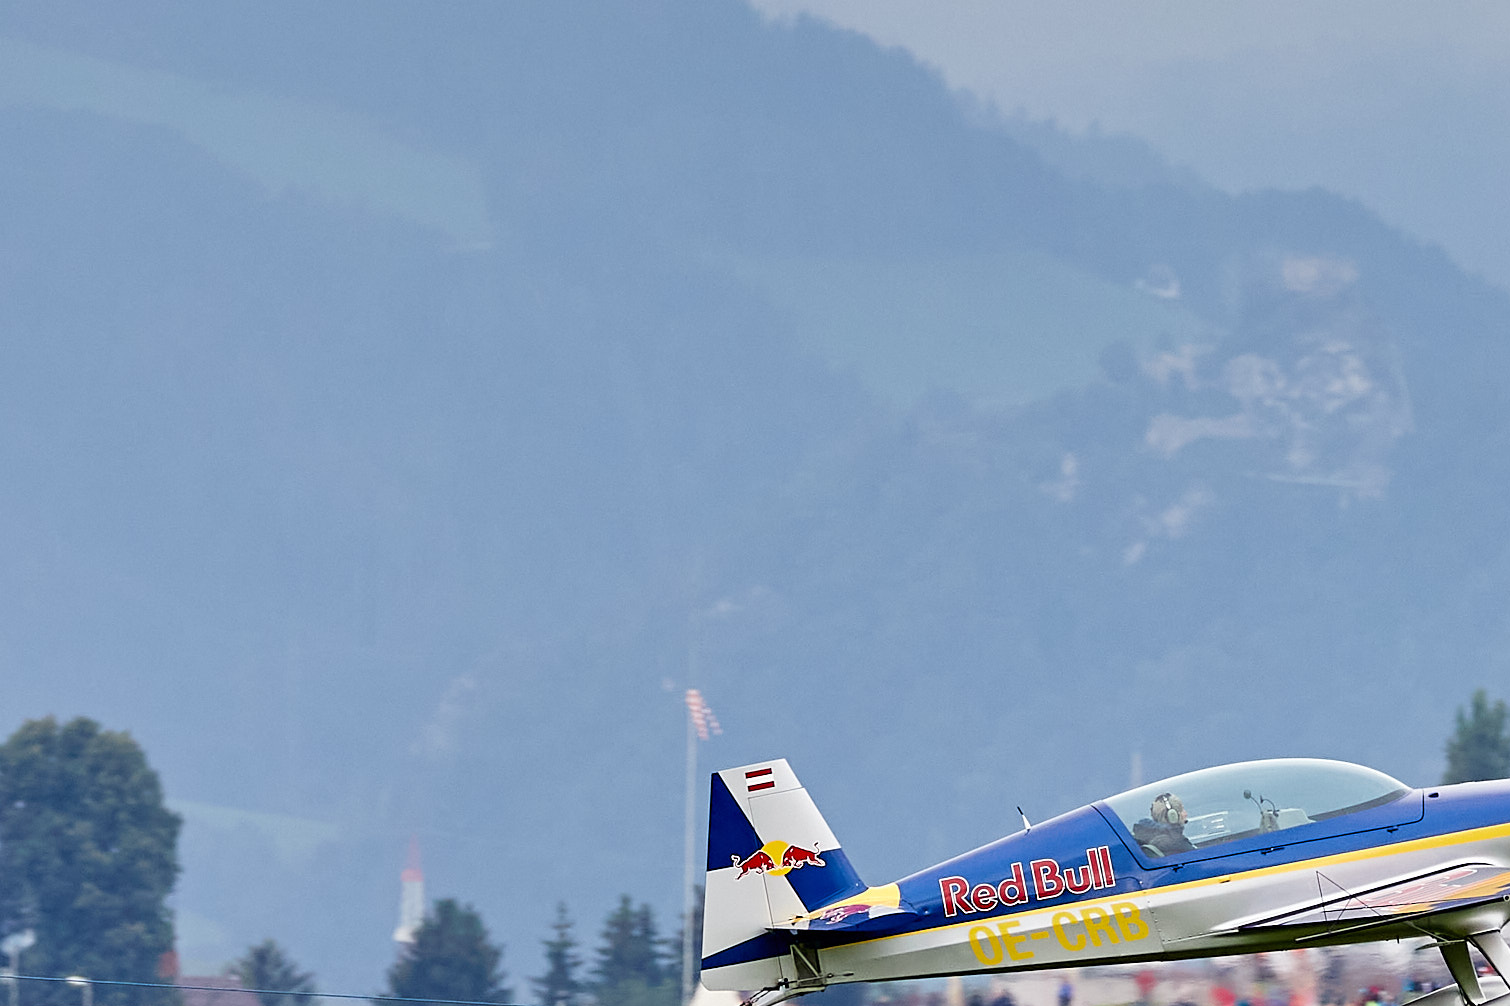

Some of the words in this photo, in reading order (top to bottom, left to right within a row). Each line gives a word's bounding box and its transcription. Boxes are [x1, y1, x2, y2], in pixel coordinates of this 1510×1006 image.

[939, 861, 1028, 917] Red
[1030, 846, 1116, 900] Bull
[968, 902, 1149, 966] OE-CRB
